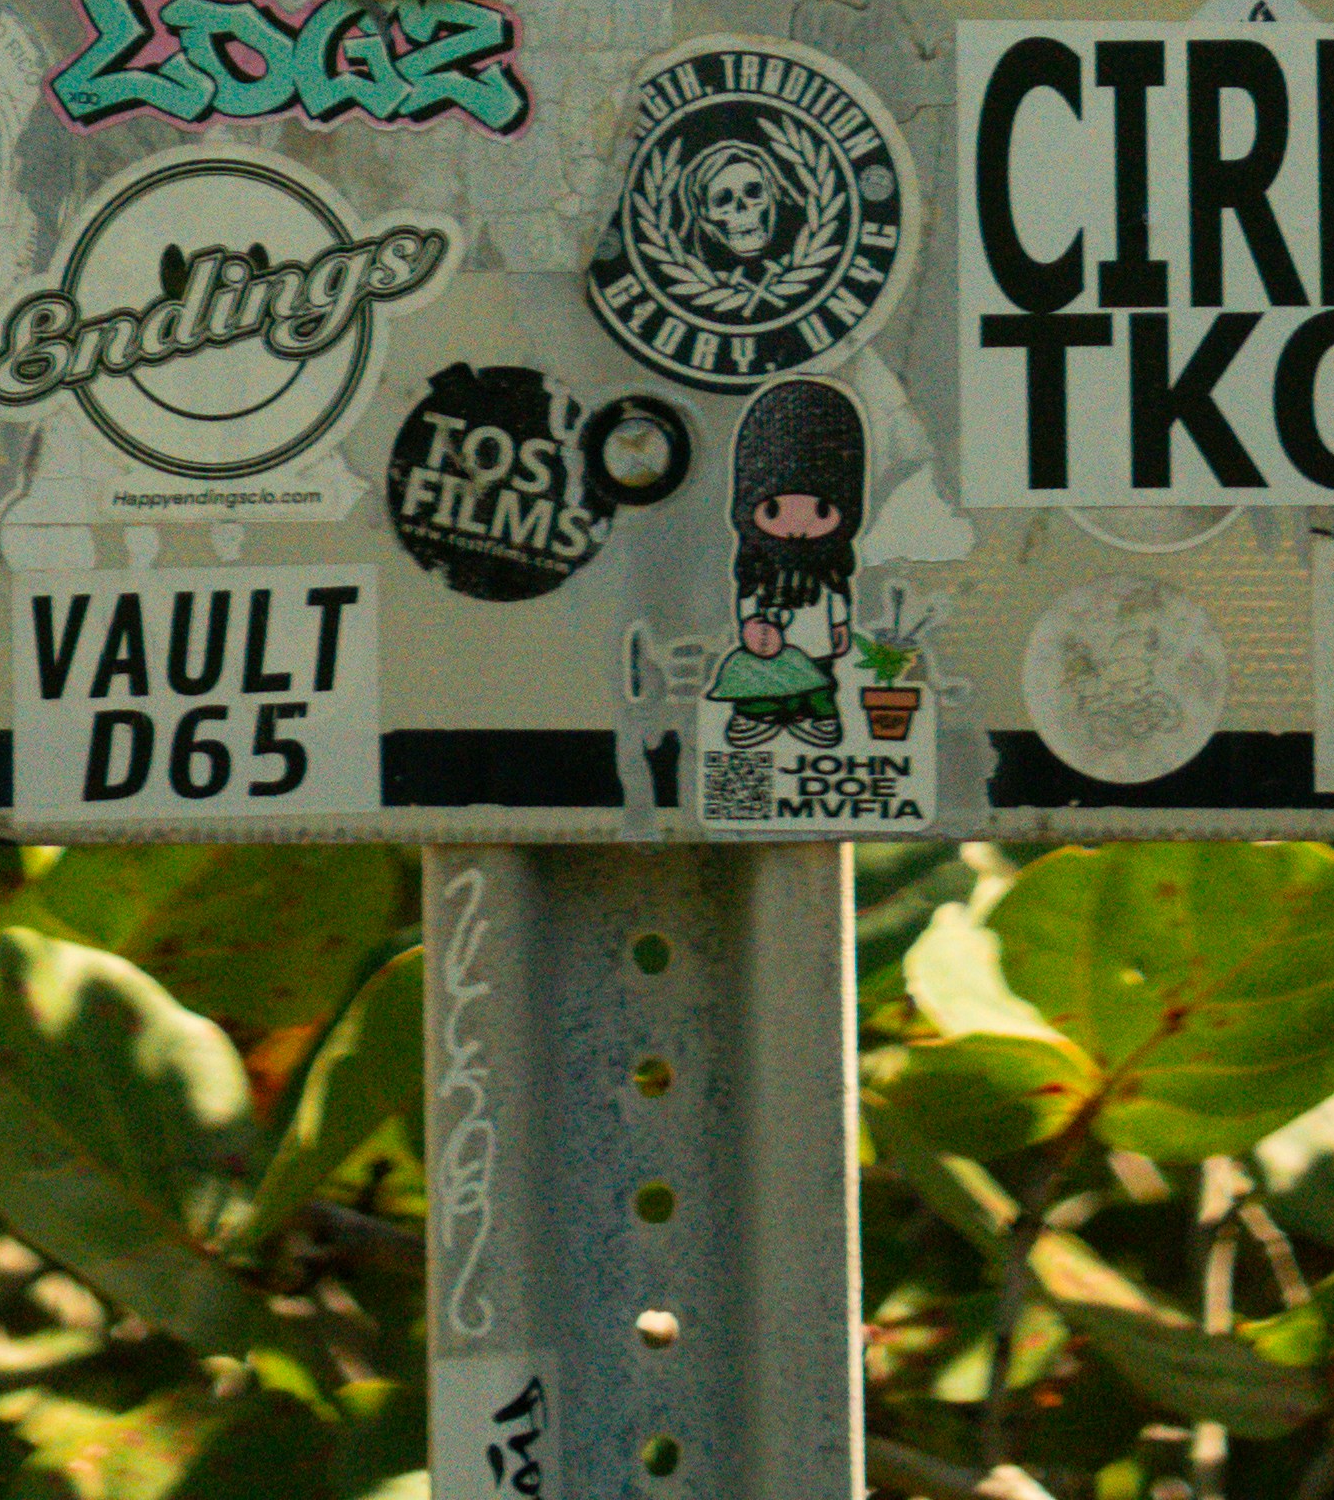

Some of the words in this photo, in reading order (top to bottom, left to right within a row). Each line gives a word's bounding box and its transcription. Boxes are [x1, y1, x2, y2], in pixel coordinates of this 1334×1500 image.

[719, 53, 882, 160] TRADITION
[400, 466, 594, 558] FILMS
[30, 586, 361, 700] VAULT
[81, 701, 309, 802] D65
[778, 754, 912, 777] JOHN
[797, 776, 898, 799] DOE
[776, 797, 924, 820] MVFIA
